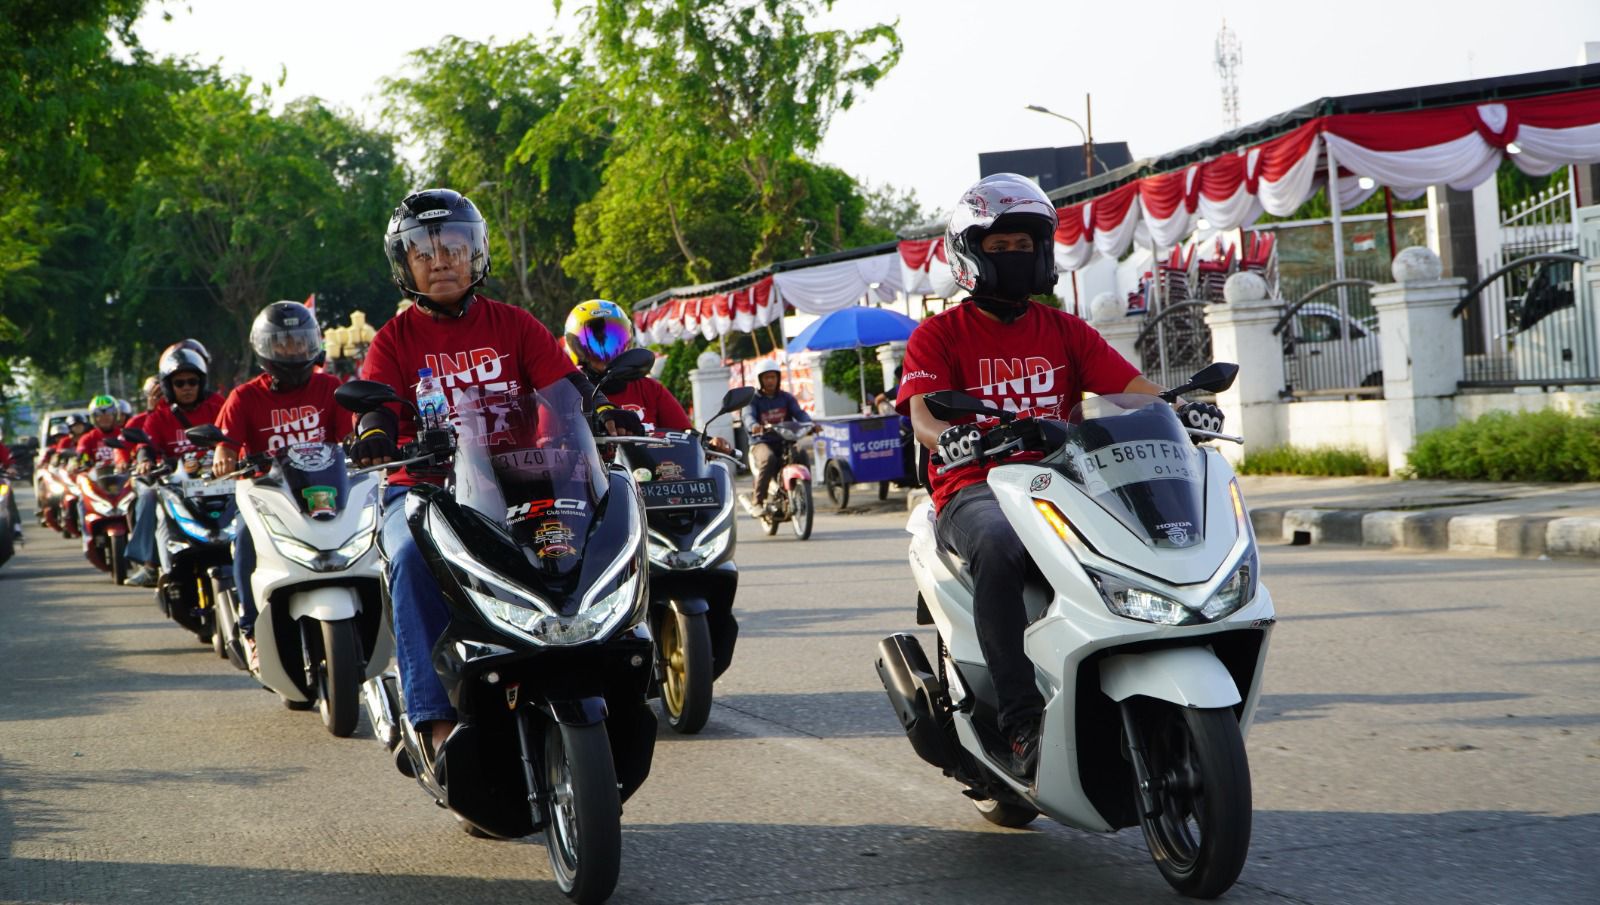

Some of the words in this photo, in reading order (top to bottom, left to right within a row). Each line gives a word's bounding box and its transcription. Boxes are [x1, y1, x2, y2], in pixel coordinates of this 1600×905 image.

[425, 347, 502, 388] IND
[979, 356, 1055, 396] IND
[271, 405, 321, 433] IND
[852, 442, 866, 452] VG
[868, 438, 900, 450] COFFEE
[1112, 443, 1157, 463] 5867
[1155, 521, 1192, 530] HONDA
